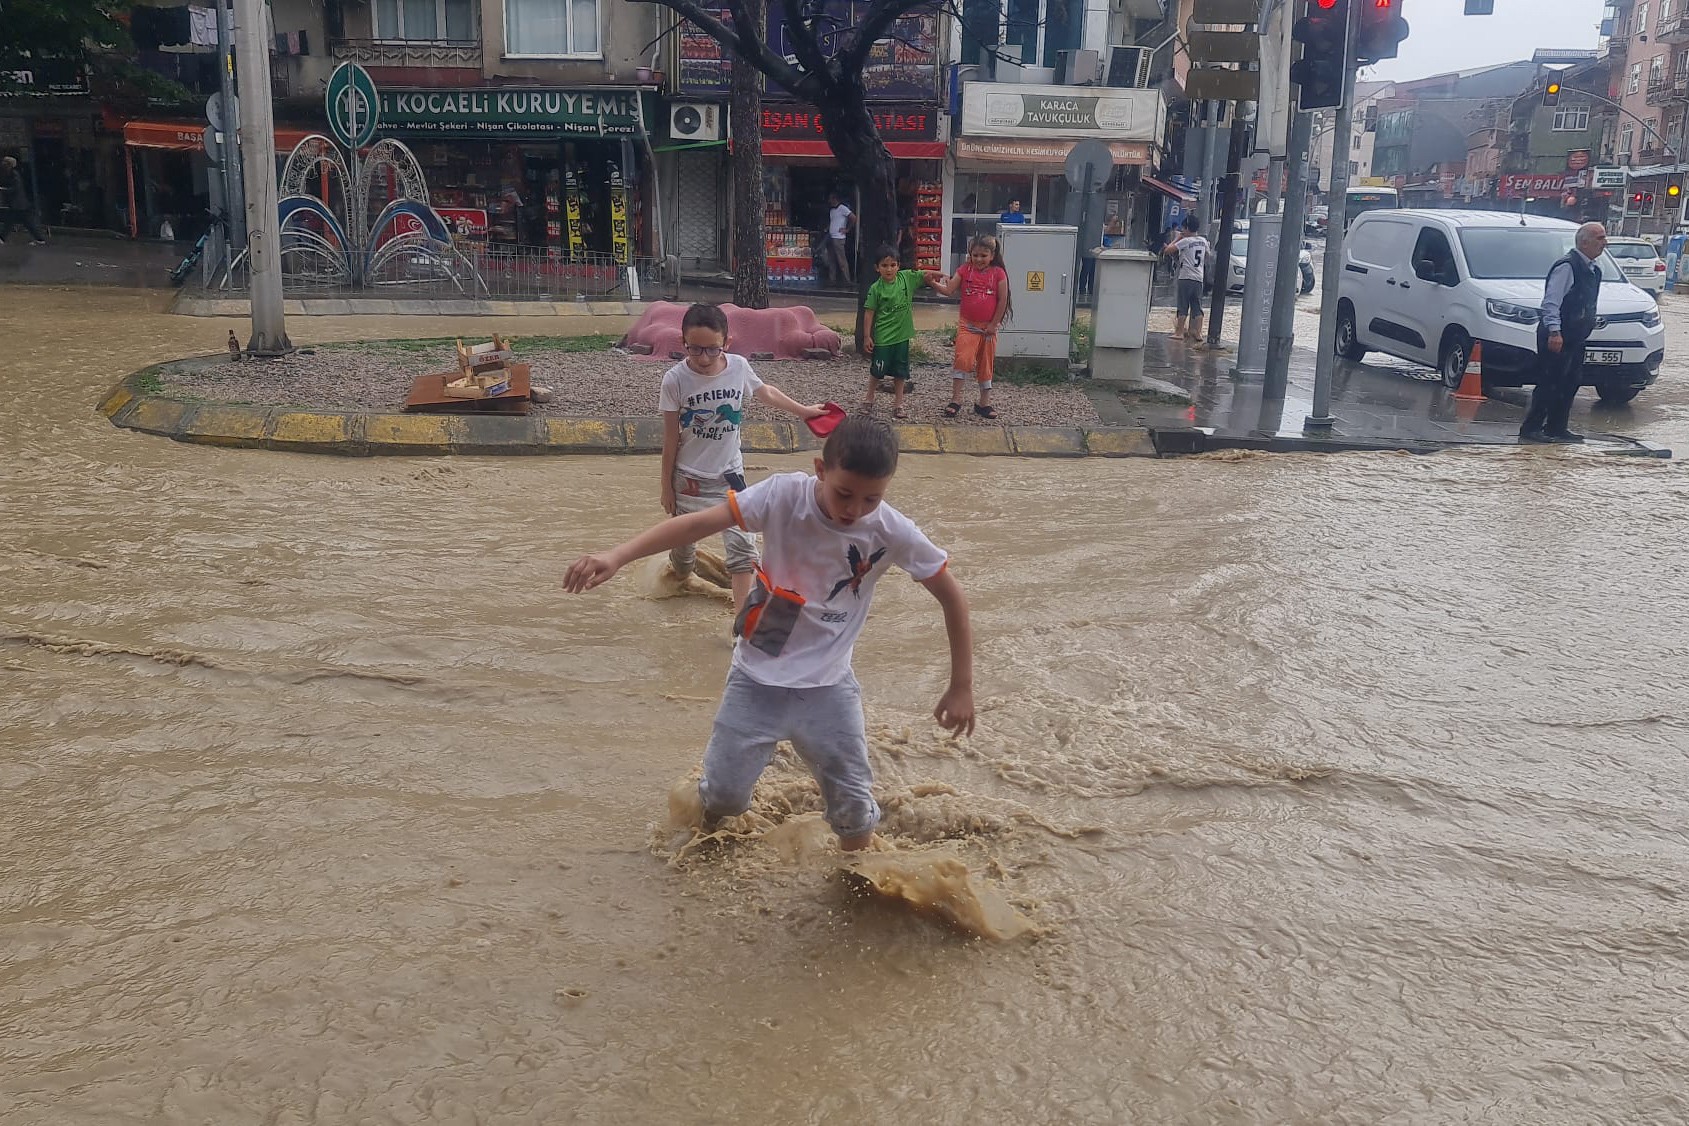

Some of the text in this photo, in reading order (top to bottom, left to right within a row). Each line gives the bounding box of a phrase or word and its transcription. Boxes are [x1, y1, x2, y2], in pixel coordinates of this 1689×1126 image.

[1040, 100, 1079, 111] KARACA
[762, 110, 809, 132] İŞAN
[1027, 112, 1091, 125] TAVUKÇULUK
[407, 122, 437, 130] Mevlüt
[440, 121, 468, 131] Şekeri
[477, 123, 504, 132] Nişan
[507, 123, 554, 132] Çikolatası
[564, 123, 596, 133] Nişan
[1194, 250, 1202, 267] 5
[1601, 352, 1619, 362] 555
[687, 388, 741, 407] #FRIENDS
[722, 425, 736, 433] ALL
[697, 432, 724, 440] TIMES
